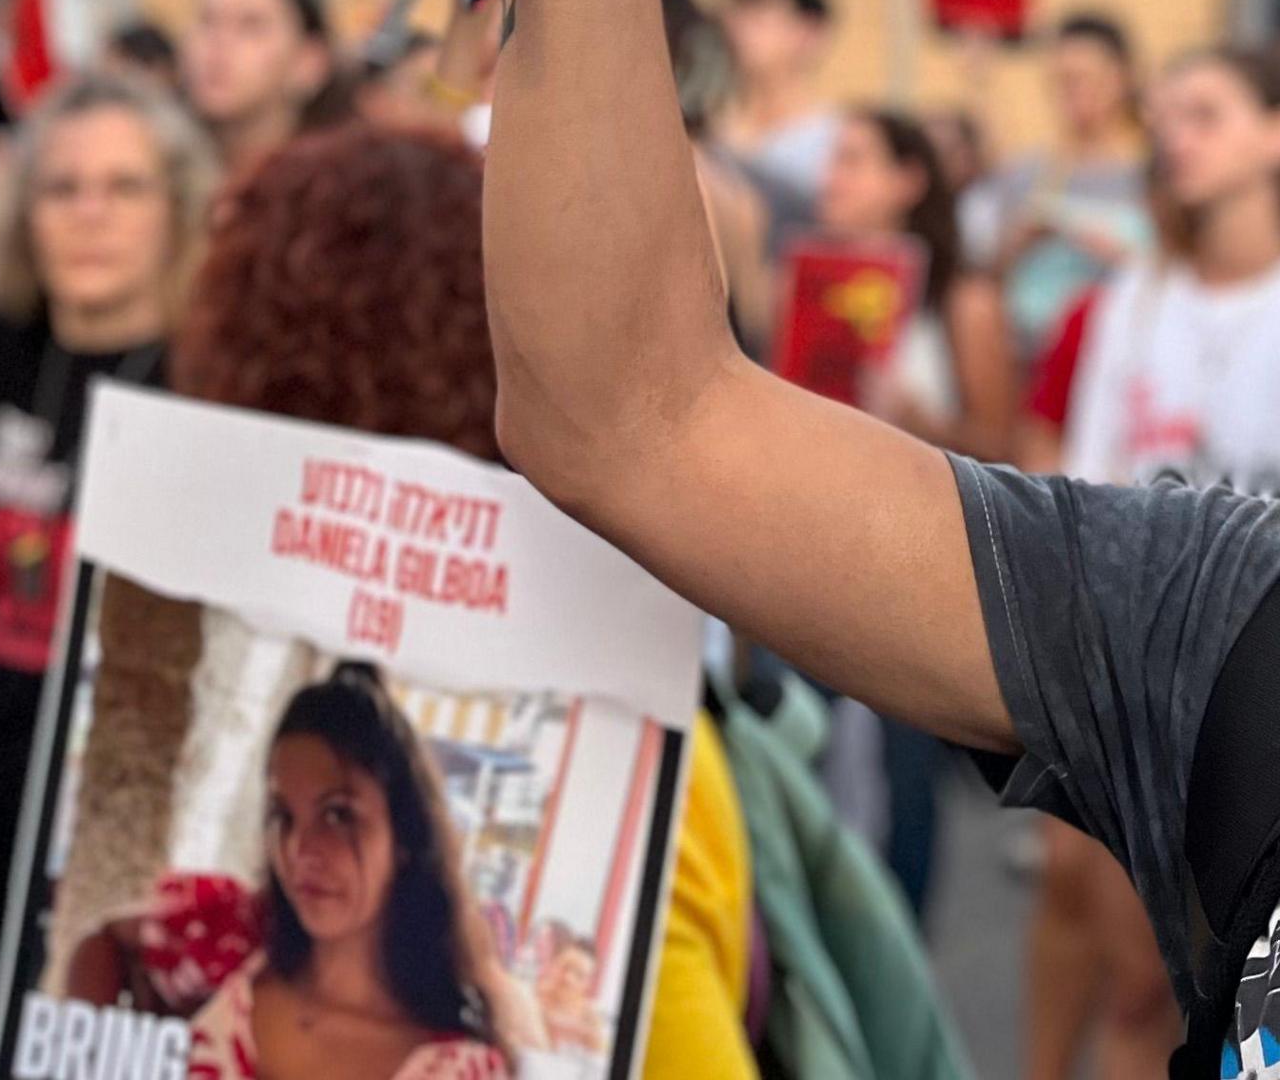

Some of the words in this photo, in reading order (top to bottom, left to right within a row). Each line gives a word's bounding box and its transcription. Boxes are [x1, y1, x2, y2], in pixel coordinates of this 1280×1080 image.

[272, 510, 388, 581] DANIELA
[396, 546, 506, 612] GILBOA
[13, 990, 194, 1080] BRING
